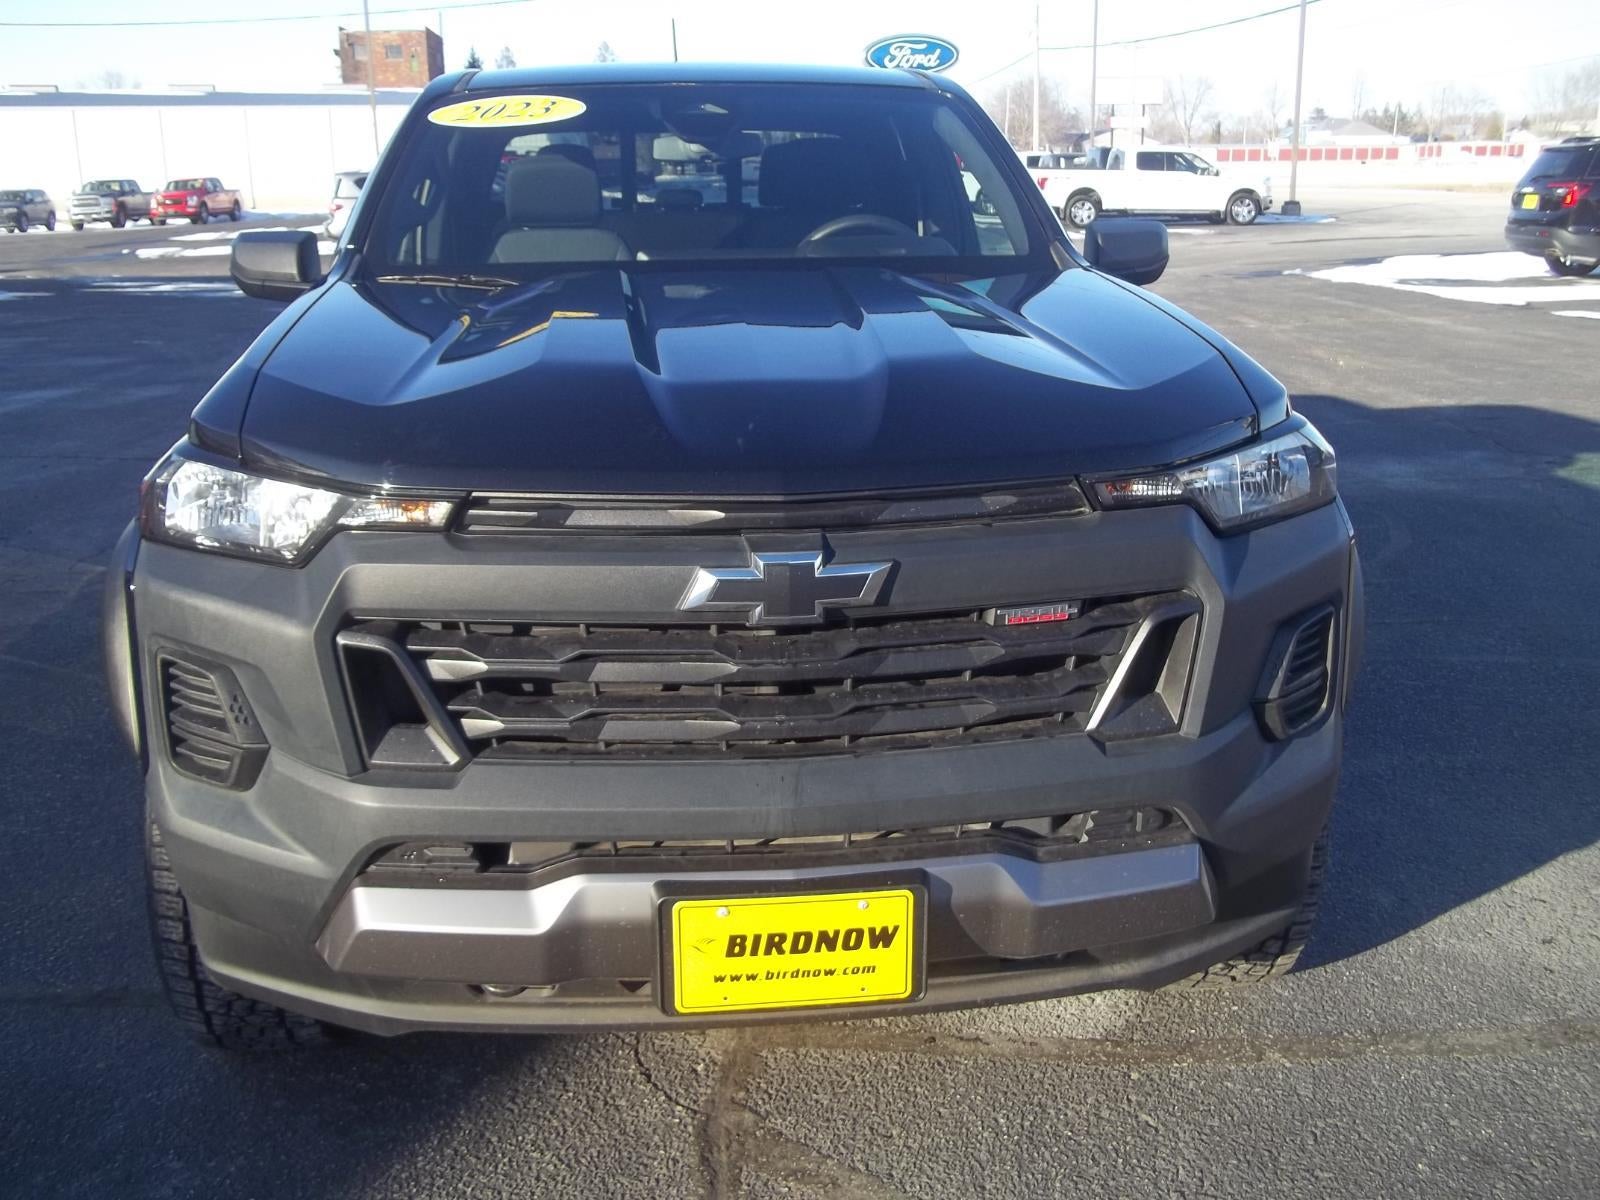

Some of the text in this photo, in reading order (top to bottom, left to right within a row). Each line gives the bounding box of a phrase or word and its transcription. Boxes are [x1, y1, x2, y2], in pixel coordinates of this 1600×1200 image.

[883, 42, 941, 69] Ford
[451, 100, 558, 122] 2023
[725, 924, 900, 958] BIRDNOW
[713, 964, 877, 984] www.birdnow.com
